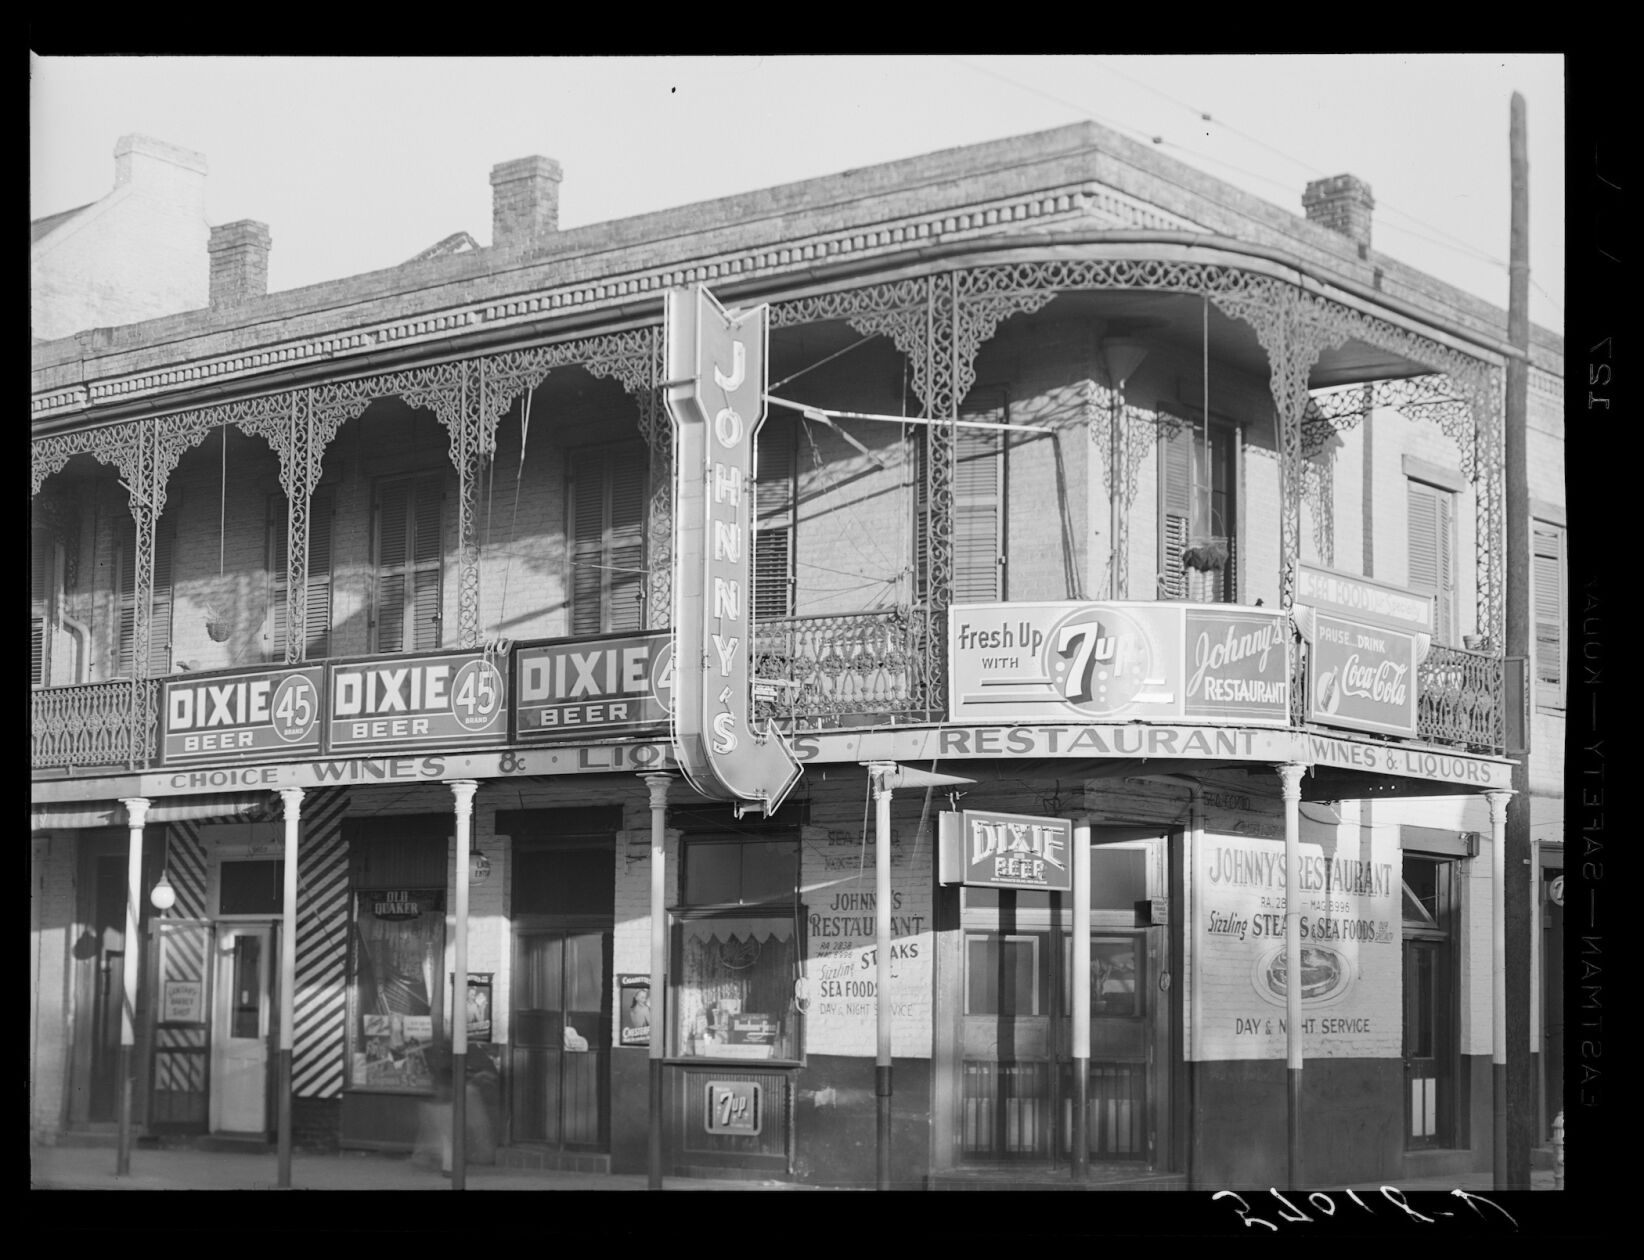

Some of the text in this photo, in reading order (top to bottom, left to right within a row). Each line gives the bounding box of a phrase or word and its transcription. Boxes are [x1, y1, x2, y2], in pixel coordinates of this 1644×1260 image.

[711, 341, 745, 753] JOHNNY'S
[958, 621, 1042, 656] Fresh Up
[1357, 635, 1386, 653] DRINK
[982, 657, 1019, 669] WITH
[1187, 617, 1285, 696] Johnny's
[522, 646, 649, 701] DIXIE
[1341, 653, 1408, 706] Coca-Cola
[335, 665, 449, 716] DIXIE
[456, 671, 495, 715] 45
[1205, 676, 1285, 704] RESTAURANT
[169, 681, 271, 730] DIXIE
[276, 683, 309, 728] 45
[541, 703, 628, 726] BEER
[352, 719, 429, 739] BEER
[465, 716, 488, 724] BRAND
[184, 732, 254, 751] BEER
[939, 728, 1258, 756] RESTAURANT
[170, 768, 279, 789] CHOICE
[313, 756, 445, 782] WINES
[499, 751, 526, 773] &
[1313, 738, 1492, 783] WINES & LIQUORS
[858, 829, 900, 846] FOD
[972, 819, 1065, 871] DIXIE
[994, 857, 1045, 879] BEER
[1209, 848, 1287, 888] JOHNNY'S
[375, 903, 418, 915] QUAKER
[386, 890, 408, 902] OLD
[830, 892, 902, 911] JOHNN'S
[810, 914, 925, 937] RESTAUANT
[1208, 910, 1247, 940] Sizzling
[1252, 914, 1309, 938] STEAS
[1317, 918, 1339, 940] SEA
[1343, 920, 1375, 942] FOODS
[861, 943, 918, 970] STAKS
[821, 981, 842, 998] SEA
[820, 1003, 837, 1015] DAY
[846, 1003, 870, 1016] NIGHT
[1236, 1018, 1370, 1035] DAY & NHT SERVICE
[720, 1091, 747, 1125] 7up
